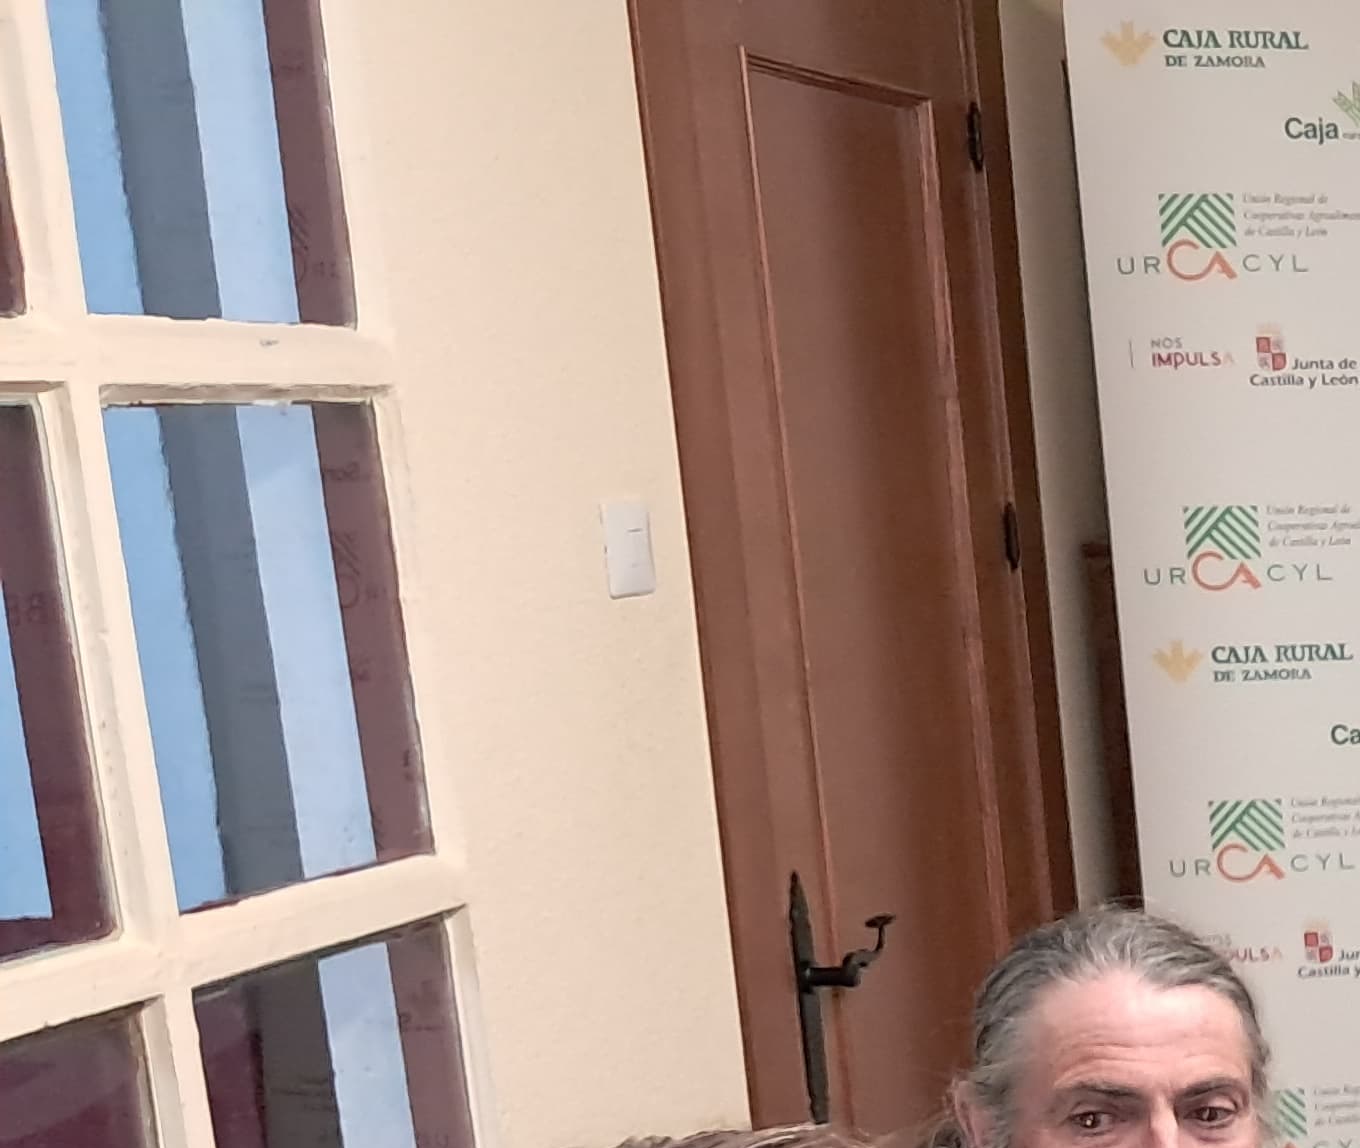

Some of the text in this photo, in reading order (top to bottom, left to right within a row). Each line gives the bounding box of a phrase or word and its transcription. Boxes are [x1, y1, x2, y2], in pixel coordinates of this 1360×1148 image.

[1163, 29, 1309, 50] CAJA RURAL
[1165, 55, 1266, 69] DE ZAMORA
[1284, 117, 1339, 145] Caja
[1291, 357, 1358, 372] Junta de
[1249, 372, 1360, 389] Castilla y León
[1211, 642, 1354, 665] CAJA RURAL
[1213, 668, 1312, 683] DE ZAMORA
